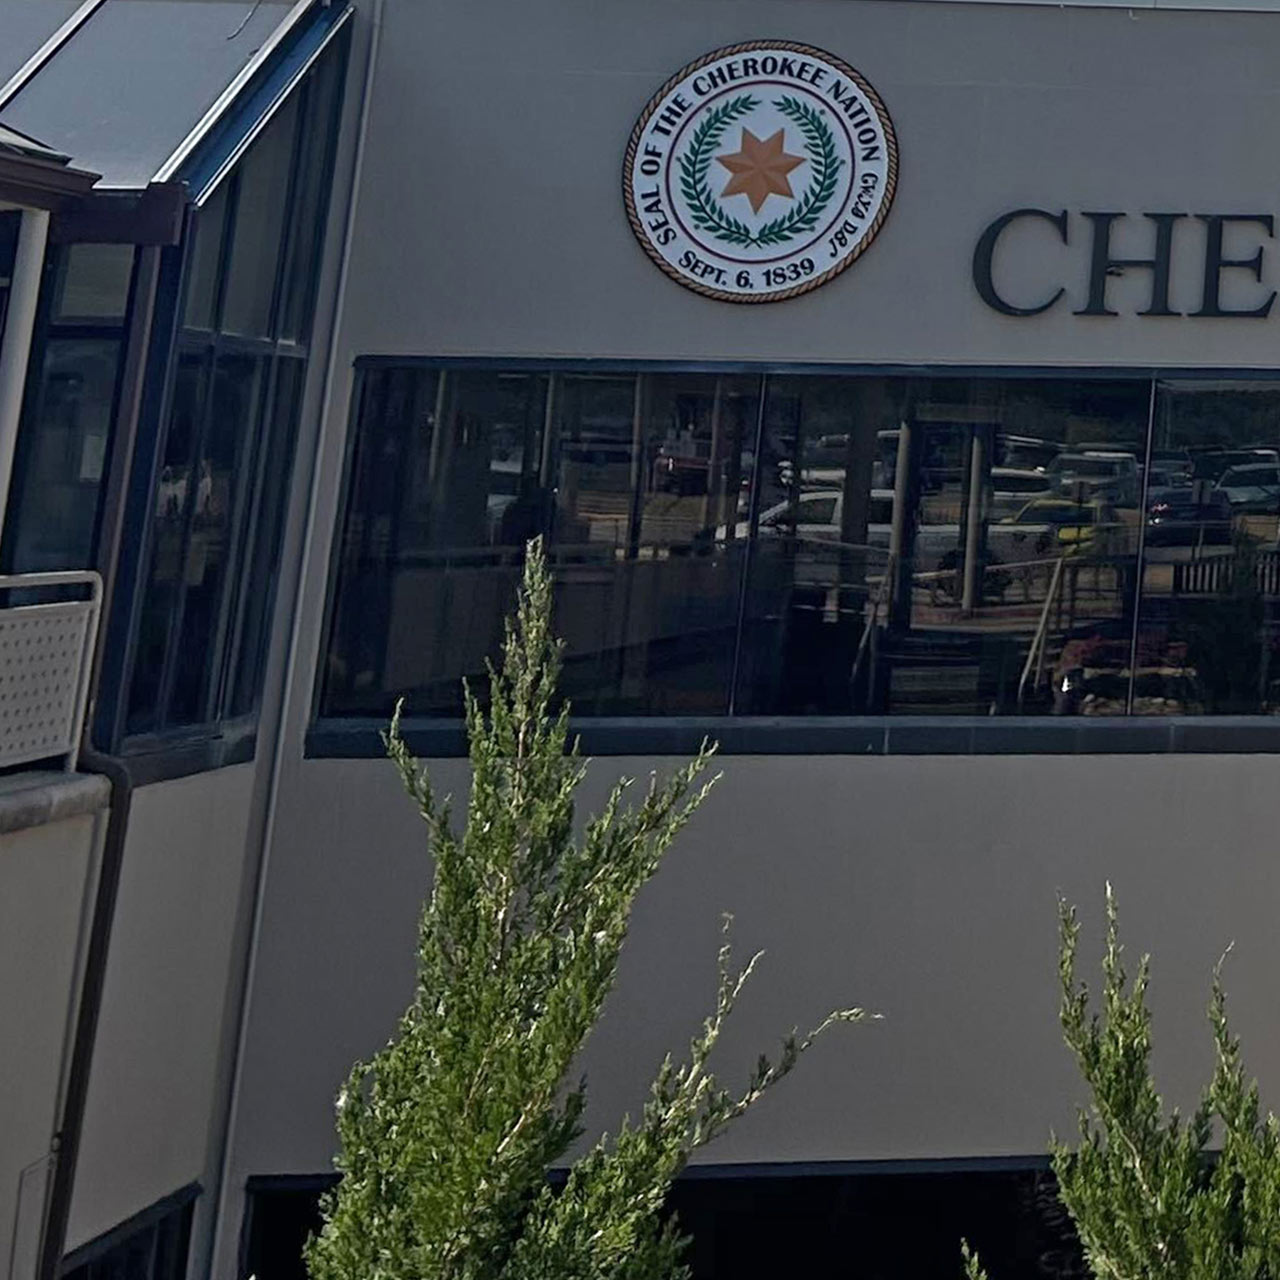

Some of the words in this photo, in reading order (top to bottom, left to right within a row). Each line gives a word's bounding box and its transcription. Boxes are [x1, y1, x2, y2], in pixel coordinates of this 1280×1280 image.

[692, 55, 829, 96] CHEROKEE
[651, 93, 693, 136] THE
[826, 79, 880, 162] NATION
[640, 142, 663, 176] OF
[641, 184, 677, 246] SEAL
[678, 250, 727, 286] SEPT.
[762, 257, 816, 287] 1839
